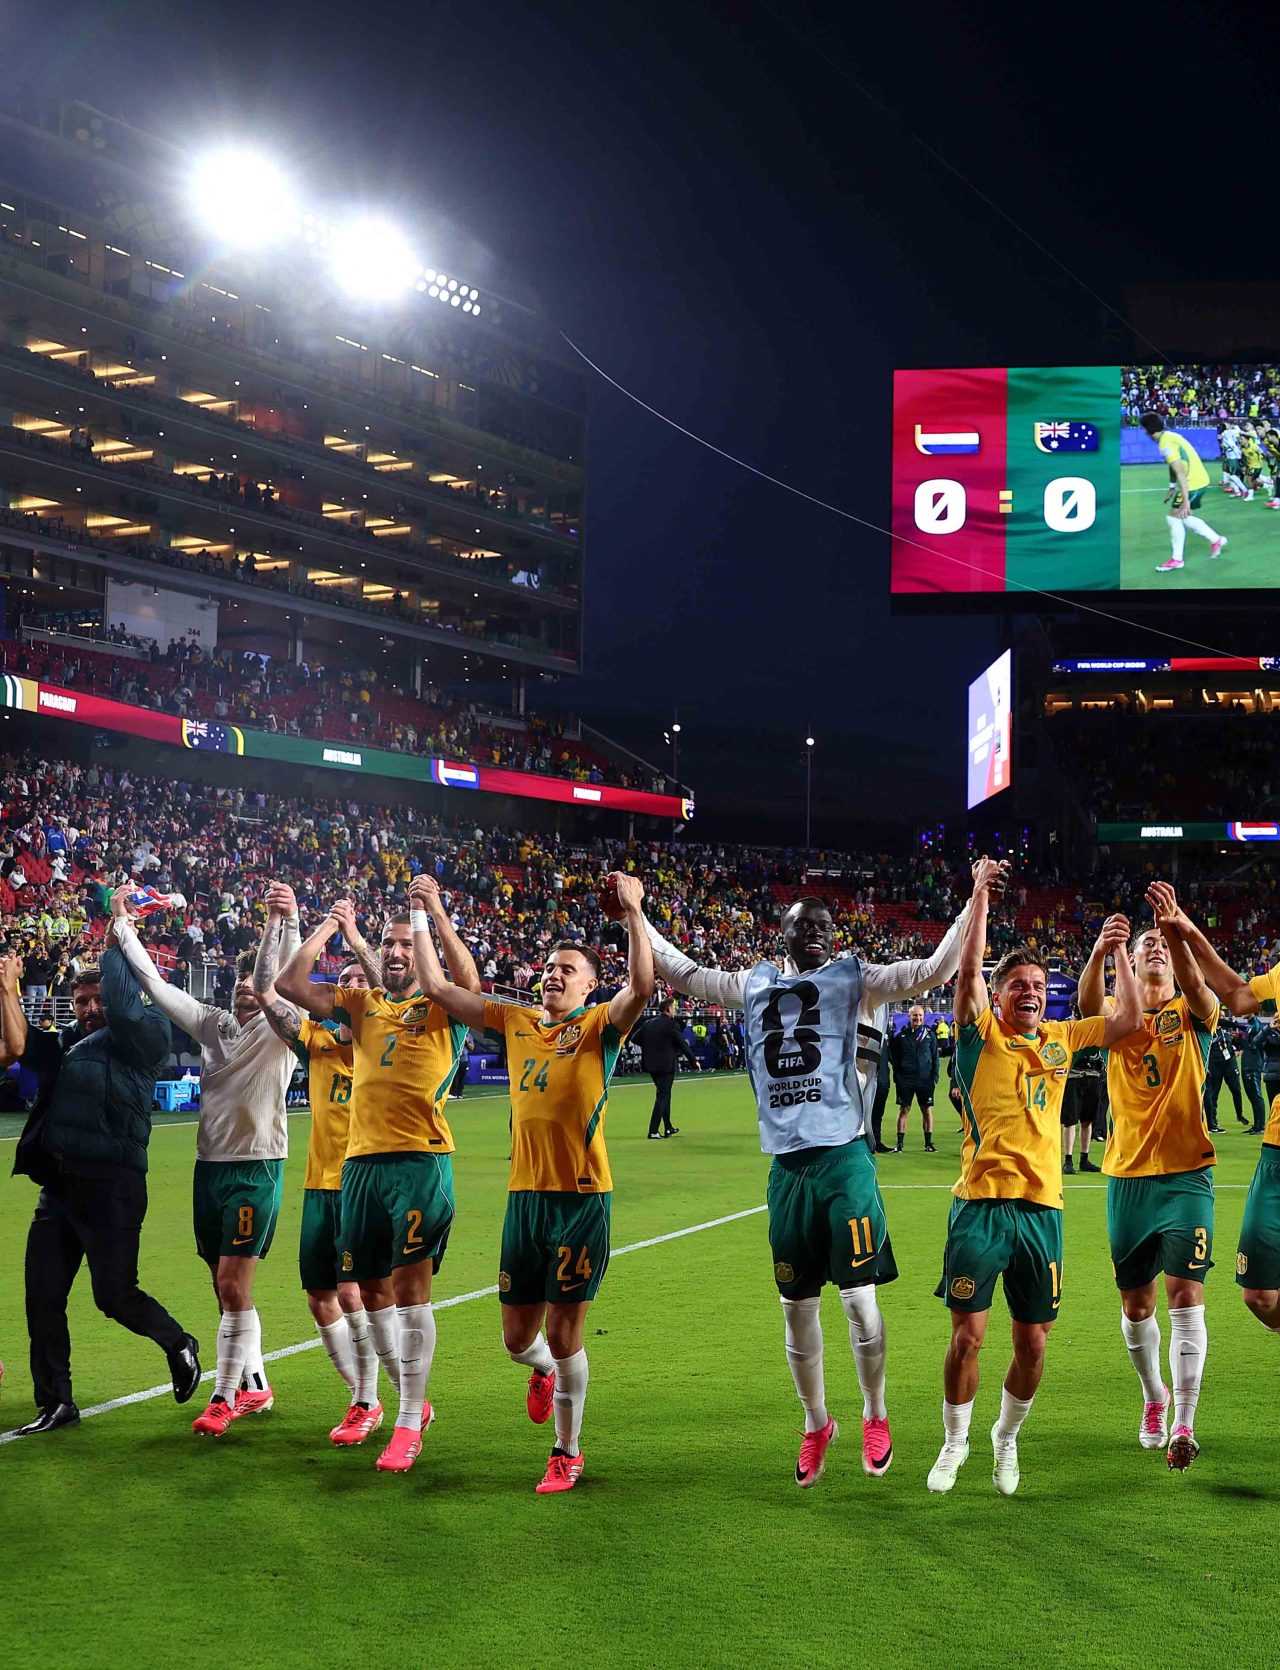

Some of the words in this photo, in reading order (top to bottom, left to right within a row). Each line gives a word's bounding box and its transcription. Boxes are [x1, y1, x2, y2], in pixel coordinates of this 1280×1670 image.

[914, 479, 966, 534] 0
[1044, 477, 1096, 532] 0
[187, 628, 201, 636] 244
[39, 691, 77, 713] PARAGUAY
[323, 748, 362, 766] AUSTRALIA
[1140, 826, 1184, 838] AUSTRALIA
[380, 1032, 396, 1067] 2
[778, 1056, 805, 1069] FIFA
[519, 1058, 550, 1092] 24
[768, 1080, 800, 1093] WORLD
[802, 1078, 822, 1087] CUP
[1142, 1054, 1161, 1087] 3
[329, 1073, 350, 1104] 13
[770, 1089, 822, 1109] 2026
[1025, 1075, 1046, 1111] 14
[239, 1207, 253, 1236] 8
[407, 1210, 424, 1243] 2
[848, 1216, 873, 1255] 11
[1194, 1227, 1208, 1261] 3
[557, 1245, 592, 1281] 24
[1048, 1258, 1064, 1298] 1
